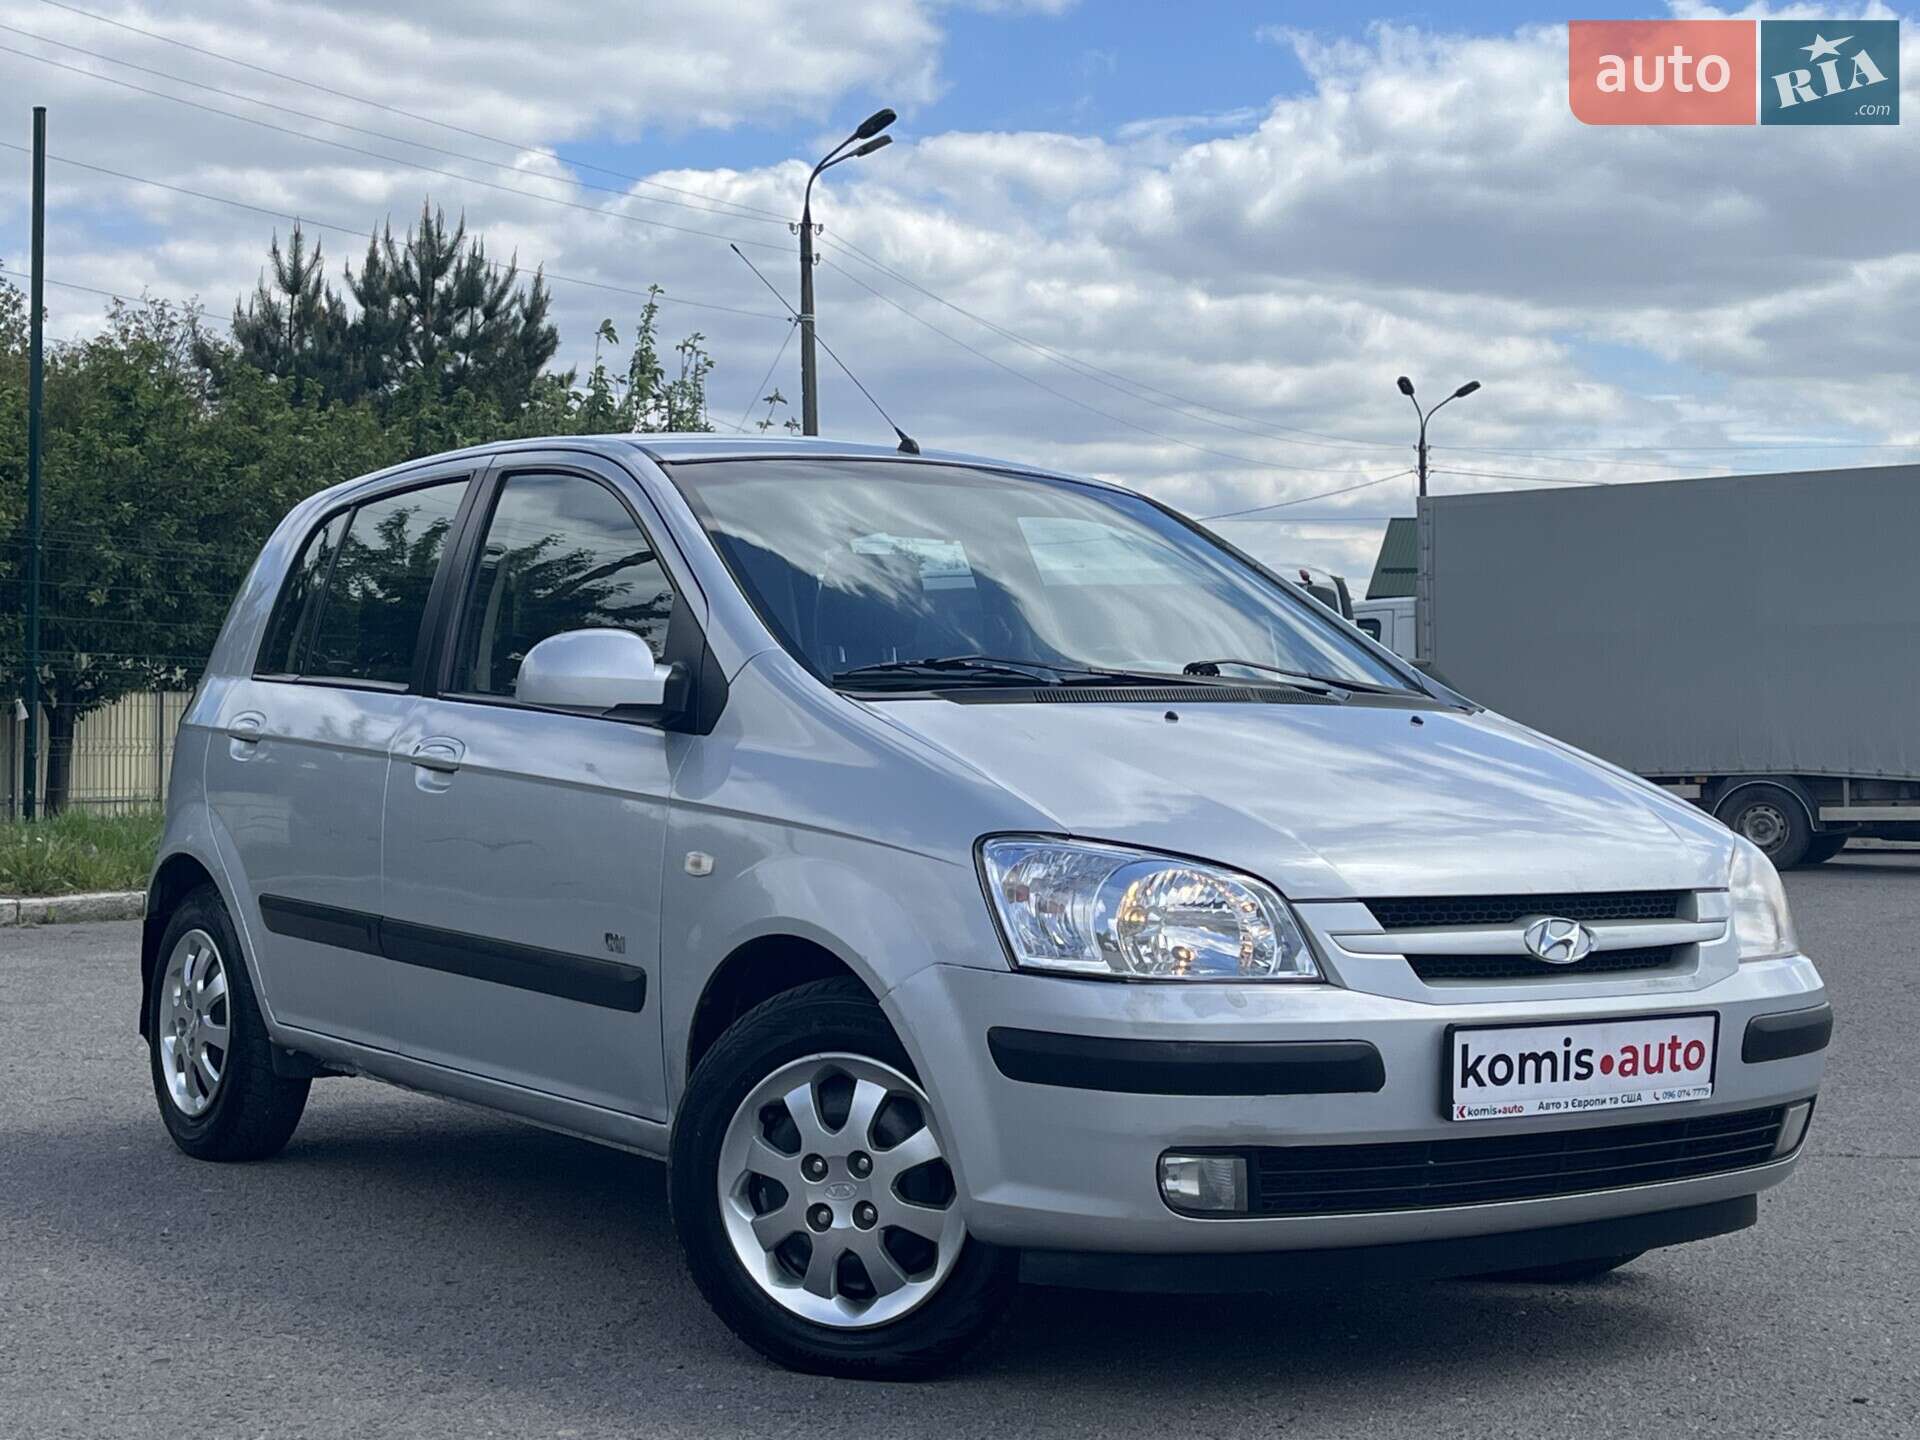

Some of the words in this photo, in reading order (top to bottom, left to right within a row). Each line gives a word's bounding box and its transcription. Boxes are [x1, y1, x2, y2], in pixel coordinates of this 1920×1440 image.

[1538, 1101, 1561, 1111] Авто
[1571, 1098, 1606, 1109] Європи
[1609, 1096, 1619, 1105] та
[1620, 1092, 1642, 1104] США
[1662, 1090, 1676, 1100] 096
